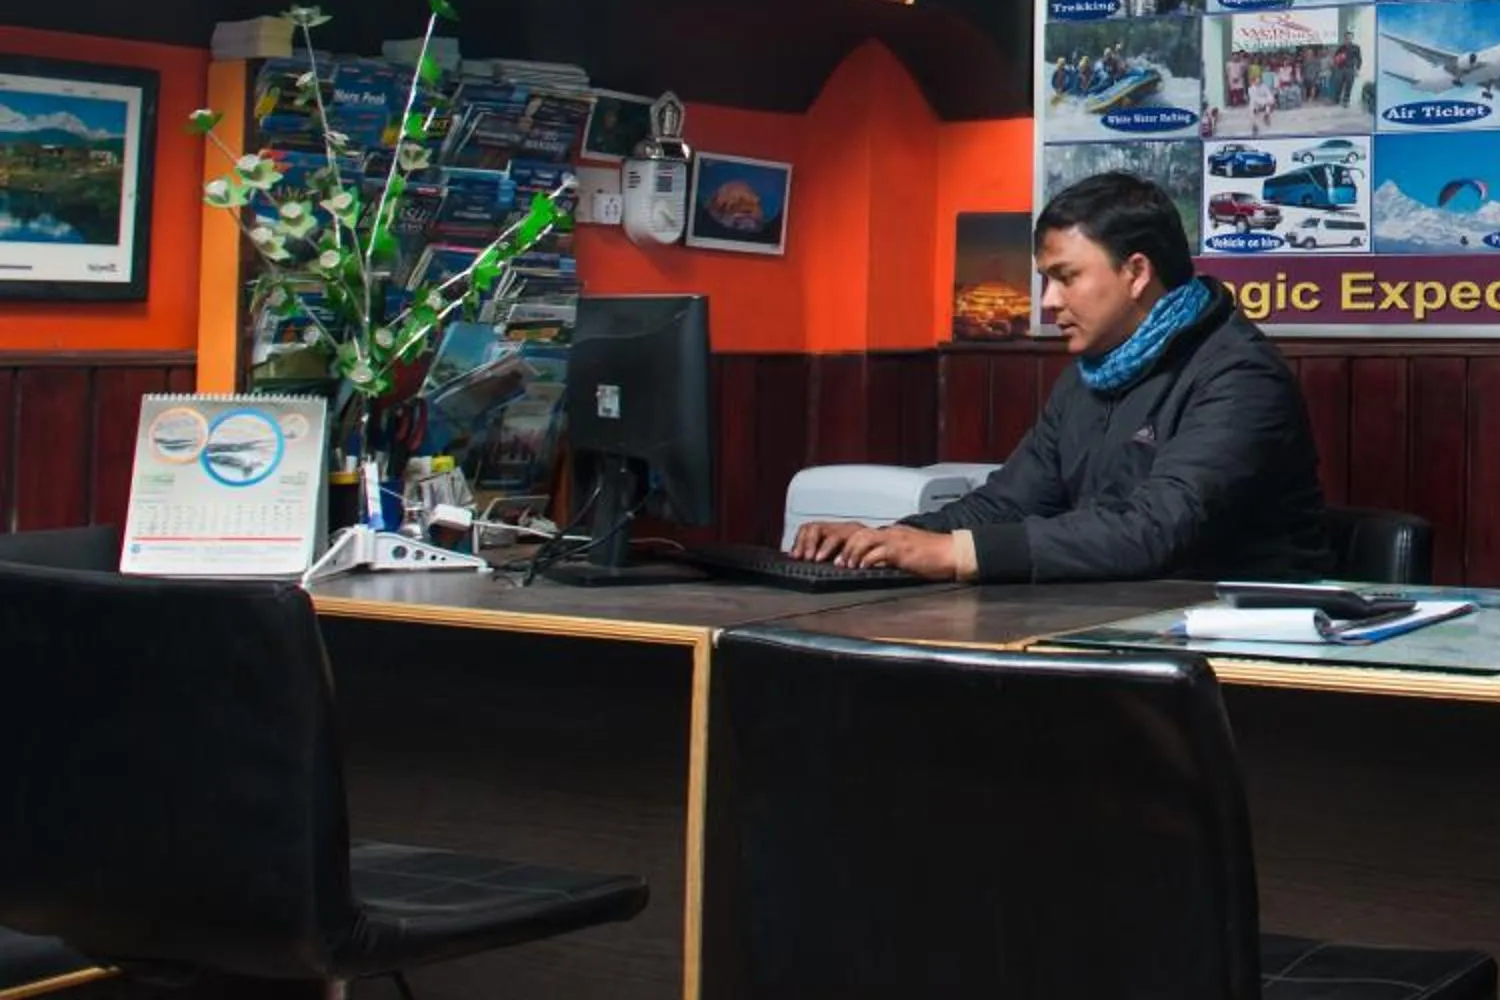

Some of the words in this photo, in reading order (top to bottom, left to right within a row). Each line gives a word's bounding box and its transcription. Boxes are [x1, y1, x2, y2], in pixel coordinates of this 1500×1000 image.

[1051, 0, 1116, 14] Trekking
[1387, 107, 1417, 119] Air
[1421, 105, 1486, 118] Ticket
[1107, 115, 1132, 125] White
[1133, 114, 1158, 124] Water
[1211, 237, 1246, 247] Vehicle
[1247, 239, 1259, 248] on
[1261, 236, 1281, 247] hire
[1220, 272, 1320, 321] gic
